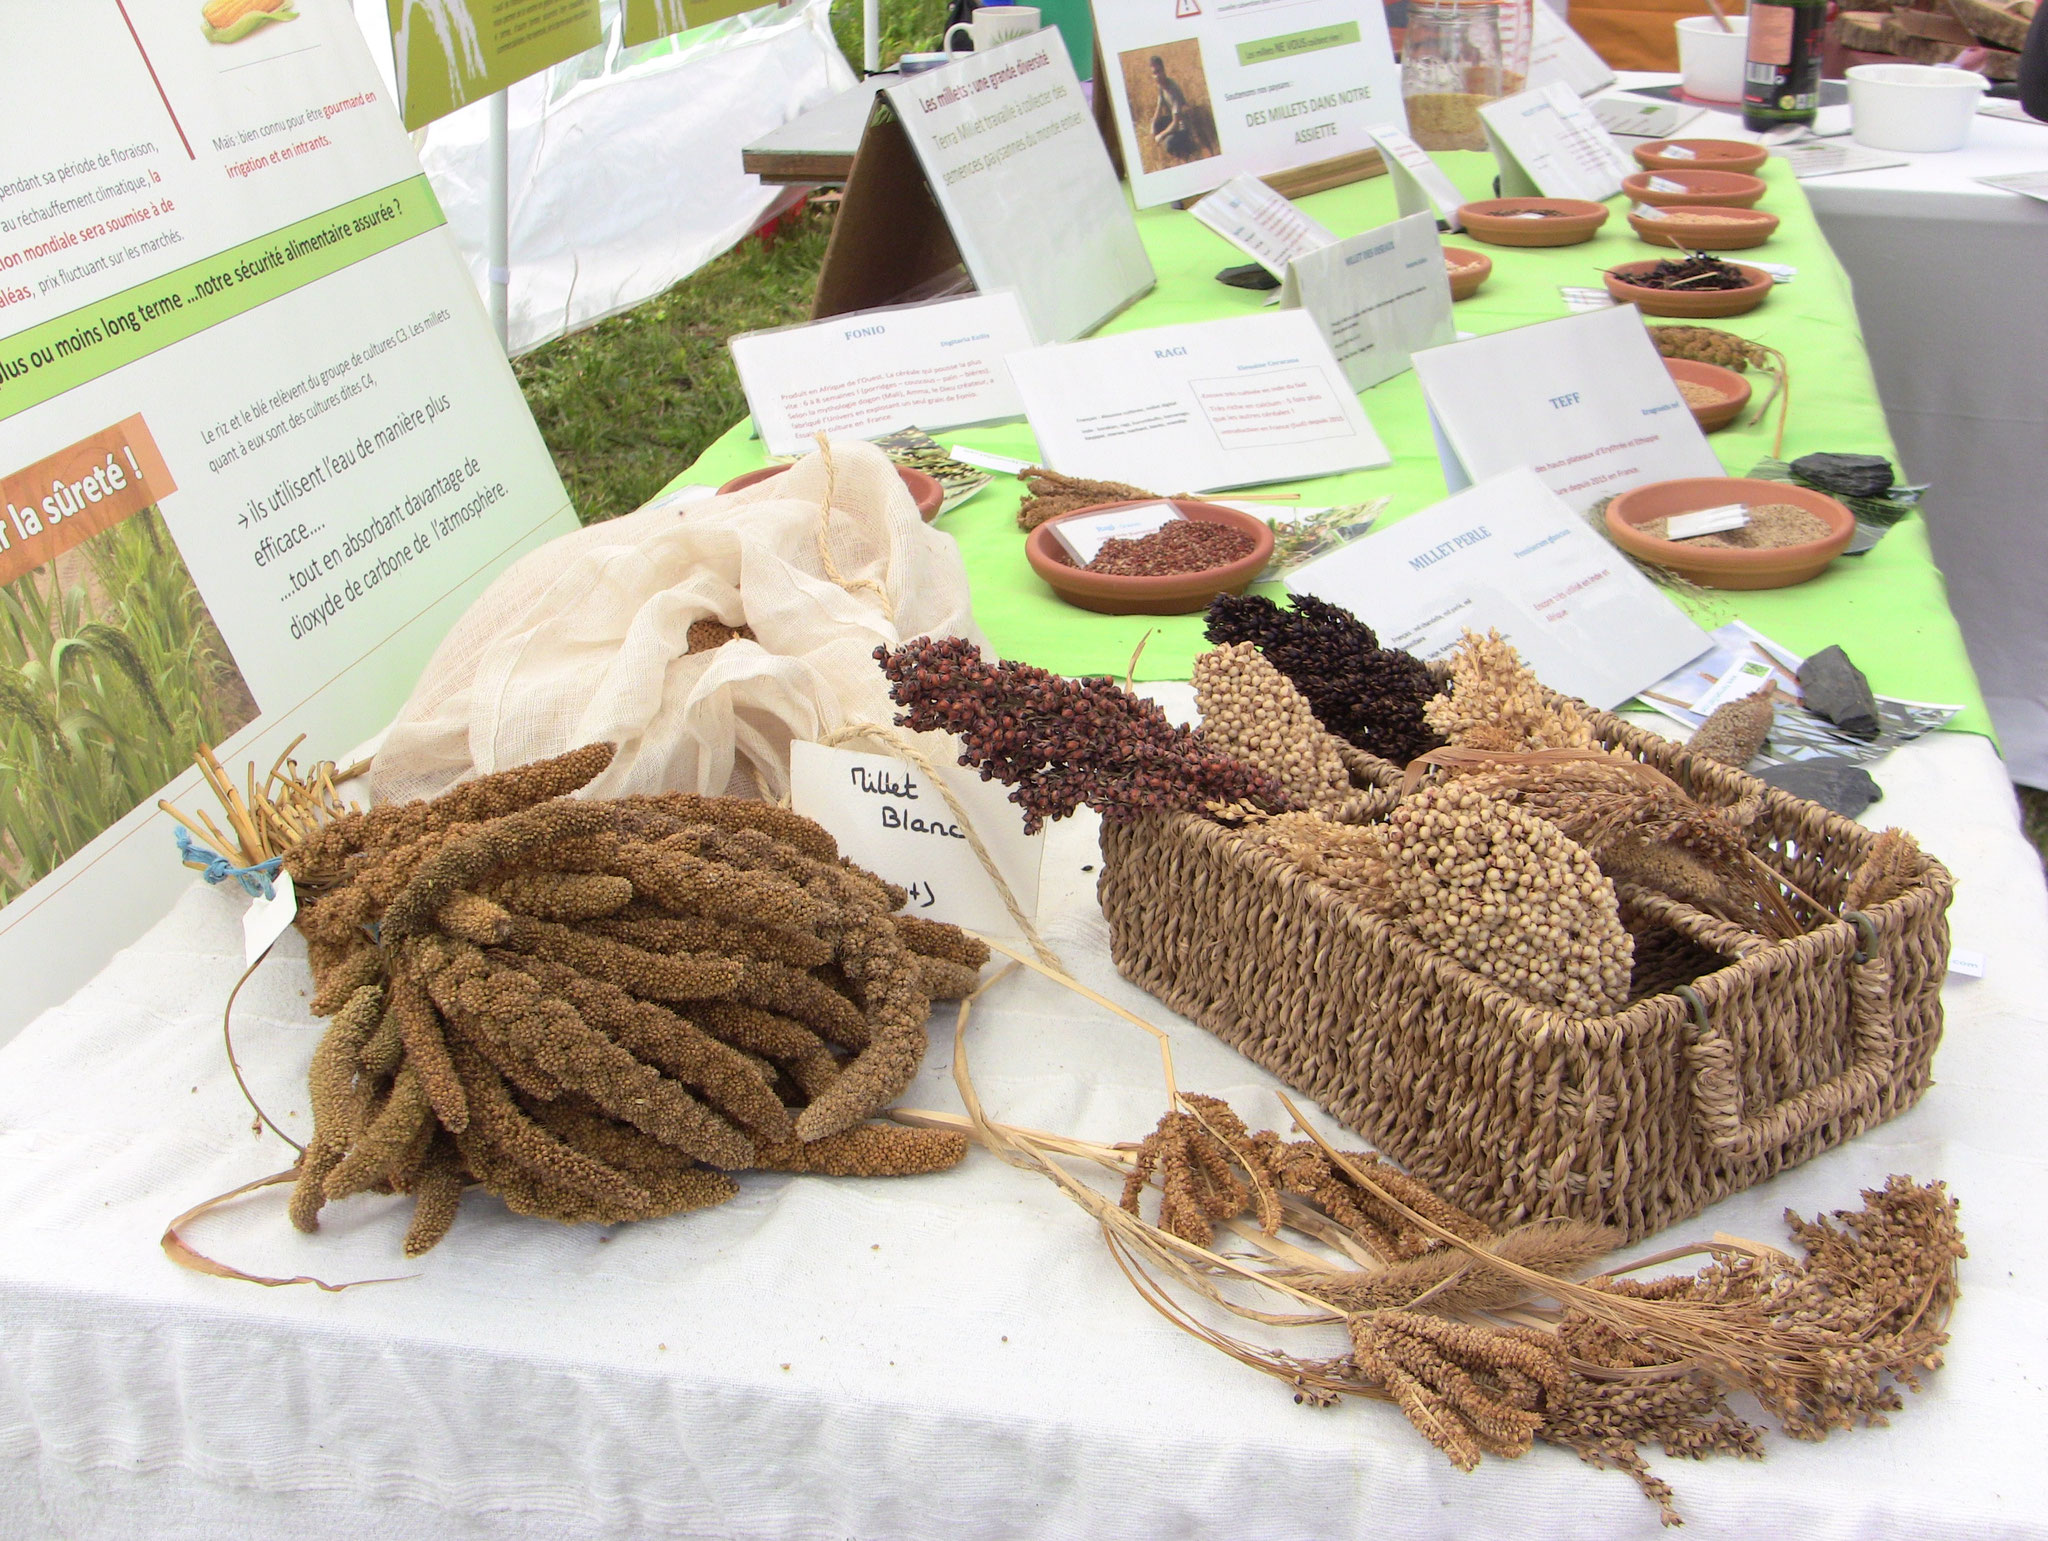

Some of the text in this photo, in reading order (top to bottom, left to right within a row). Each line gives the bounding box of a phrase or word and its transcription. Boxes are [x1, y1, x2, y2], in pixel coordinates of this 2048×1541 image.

[919, 50, 1050, 113] Les millets une grande diversité
[1246, 86, 1371, 127] DES MILLETS DANS NOTRE
[212, 91, 376, 151] Maïs bien connu pour être gourmand en
[933, 84, 1067, 151] Terra Millet travaille à collecter des
[943, 111, 1086, 186] semences paysannes du monde entier.
[1295, 123, 1337, 144] ASSIETTE
[0, 140, 159, 200] pendant sa période de floraison,
[225, 134, 331, 179] irrigation et en intrants.
[0, 168, 162, 232] au réchauffement climatique, la
[24, 229, 78, 262] mondiale
[79, 222, 106, 242] sera
[106, 206, 151, 232] soumise
[150, 200, 160, 216] à
[161, 197, 175, 213] de
[30, 347, 54, 369] ou
[55, 324, 103, 359] moins
[101, 312, 141, 338] long
[138, 291, 183, 324] terme
[188, 271, 234, 303] ...notre
[234, 247, 285, 282] sécurité
[285, 220, 353, 263] alimentaire
[352, 202, 395, 234] assurée
[39, 275, 59, 296] prix
[59, 256, 108, 285] fluctuant
[108, 249, 124, 267] sur
[124, 244, 140, 260] les
[141, 227, 185, 255] marchés.
[844, 325, 886, 340] FONIO
[1154, 346, 1188, 360] RAGI
[201, 308, 451, 445] Le riz et le blé relèvent du groupe de cultures C3. Les millets
[1548, 392, 1580, 409] TEFF
[209, 373, 378, 474] quant à eux sont des cultures dites C4,
[248, 393, 451, 522] ils utilisent l'eau de manière plus
[7, 503, 42, 540] la
[43, 453, 127, 524] sûreté
[322, 549, 343, 570] en
[343, 506, 405, 559] absorbant
[404, 466, 464, 517] davantage
[463, 456, 481, 475] de
[254, 522, 326, 567] efficace....
[290, 482, 510, 640] dioxyde de carbone de l'atmosphère.
[1408, 525, 1492, 571] MILLET PERLE
[850, 766, 919, 800] Millet
[881, 805, 968, 840] Blanc
